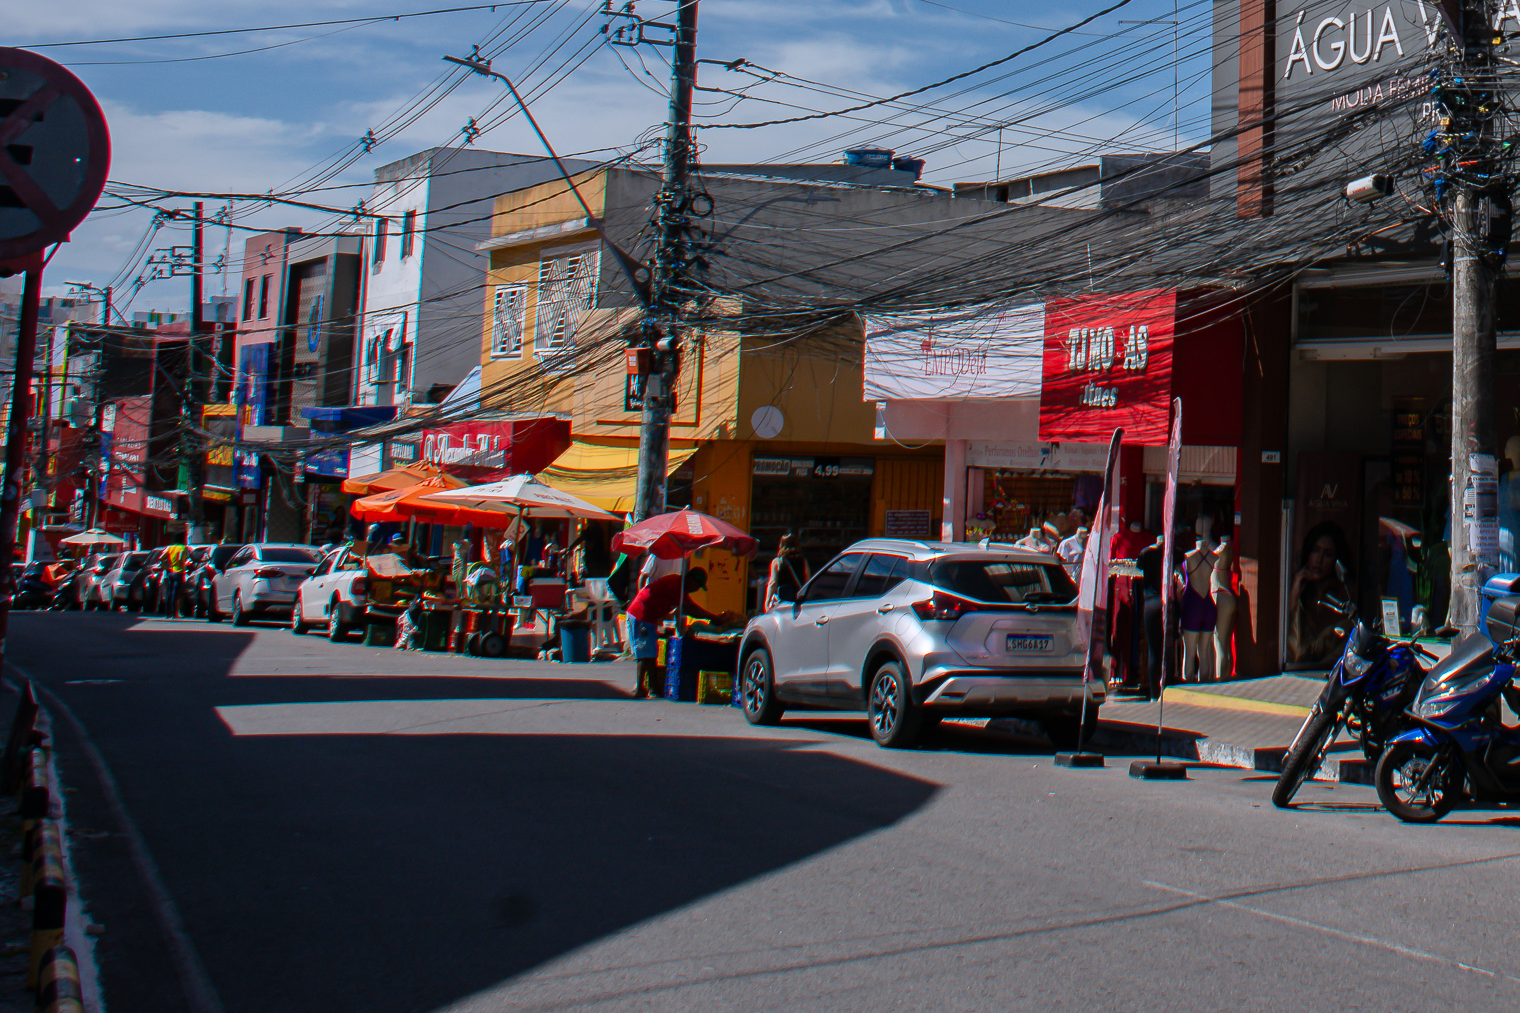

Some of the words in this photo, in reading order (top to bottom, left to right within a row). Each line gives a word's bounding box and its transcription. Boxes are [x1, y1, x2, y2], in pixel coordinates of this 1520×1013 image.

[1283, 6, 1406, 81] ÁGUA
[1265, 453, 1277, 461] 491
[814, 464, 840, 477] 4,99
